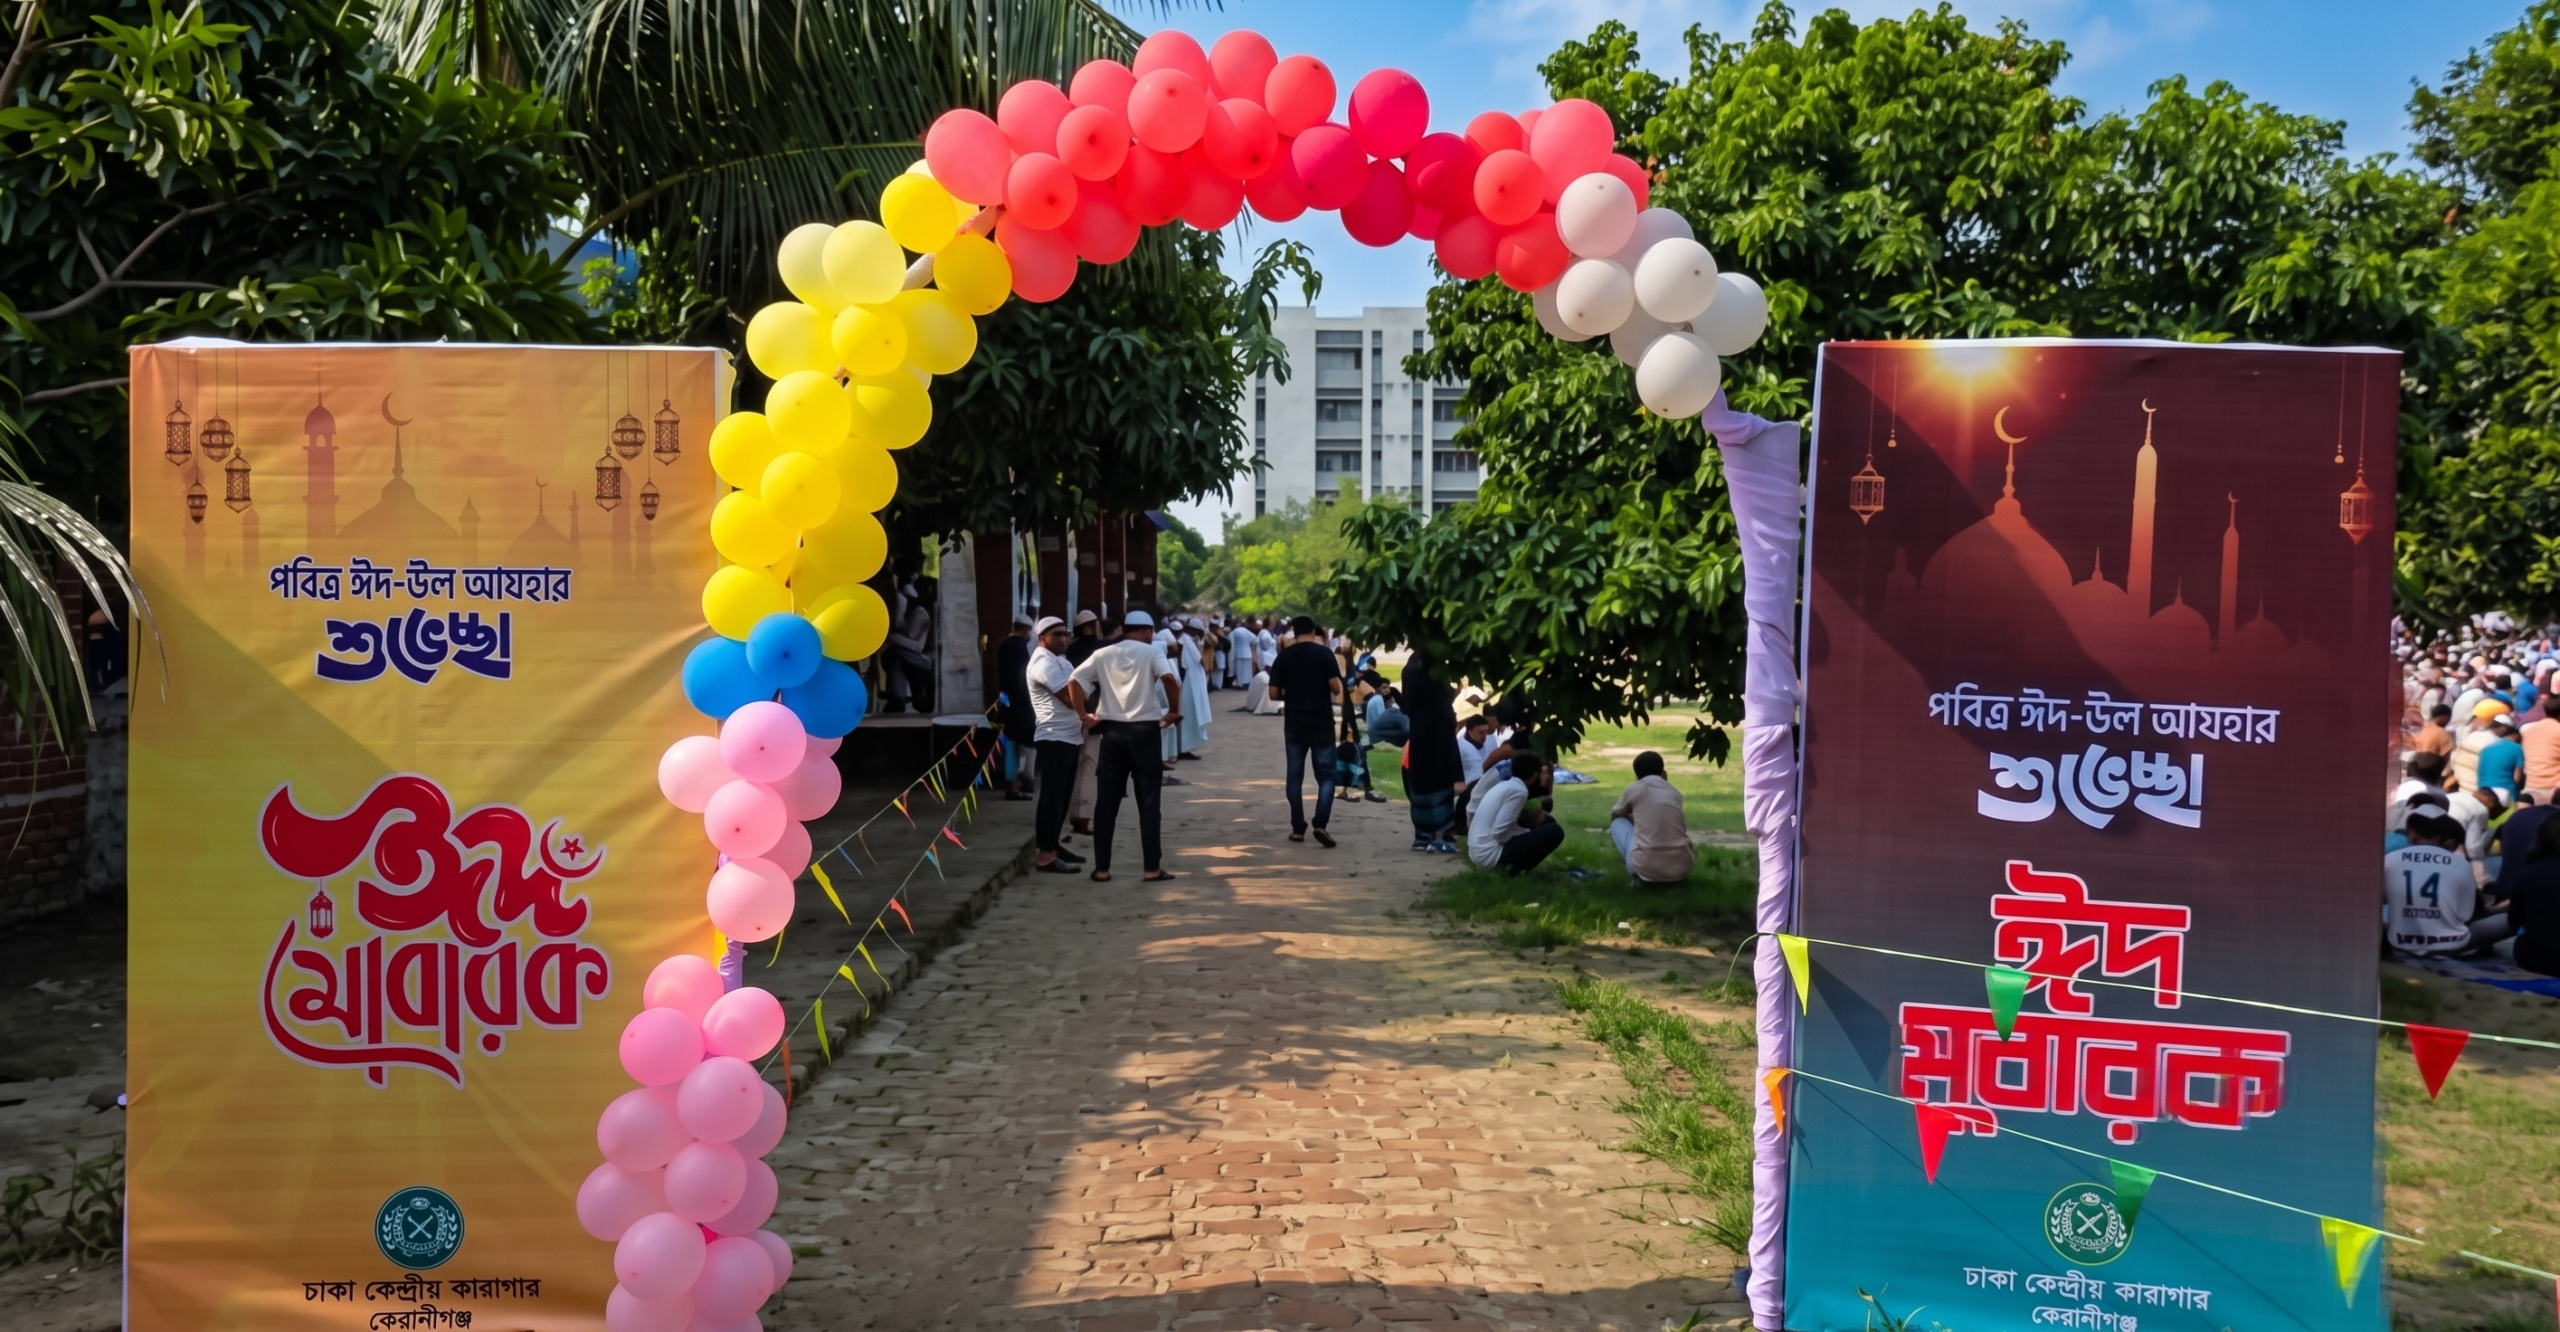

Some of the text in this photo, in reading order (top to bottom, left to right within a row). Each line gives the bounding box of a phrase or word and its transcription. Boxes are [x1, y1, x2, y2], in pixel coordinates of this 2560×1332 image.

[270, 556, 572, 602] পবিত্র ঈদ-উল আযহার
[316, 607, 511, 684] শুভেচ্ছা
[1929, 682, 2280, 744] পবিত্র ঈদ-উল আযহার
[1977, 744, 2204, 829] শুভেচ্ছা
[260, 772, 592, 949] ঈদ
[2403, 870, 2441, 908] 14
[1991, 860, 2191, 1016] ঈদ
[263, 917, 611, 1090] মোবারক
[1899, 1002, 2291, 1145] মুবারক
[365, 1273, 443, 1303] কেন্দ্রীয়
[449, 1277, 542, 1299] কারাগার
[370, 1304, 472, 1330] কেরানীগঞ্জ
[1963, 1265, 2212, 1311] ঢাকা কেন্দ্রীয় কারাগার
